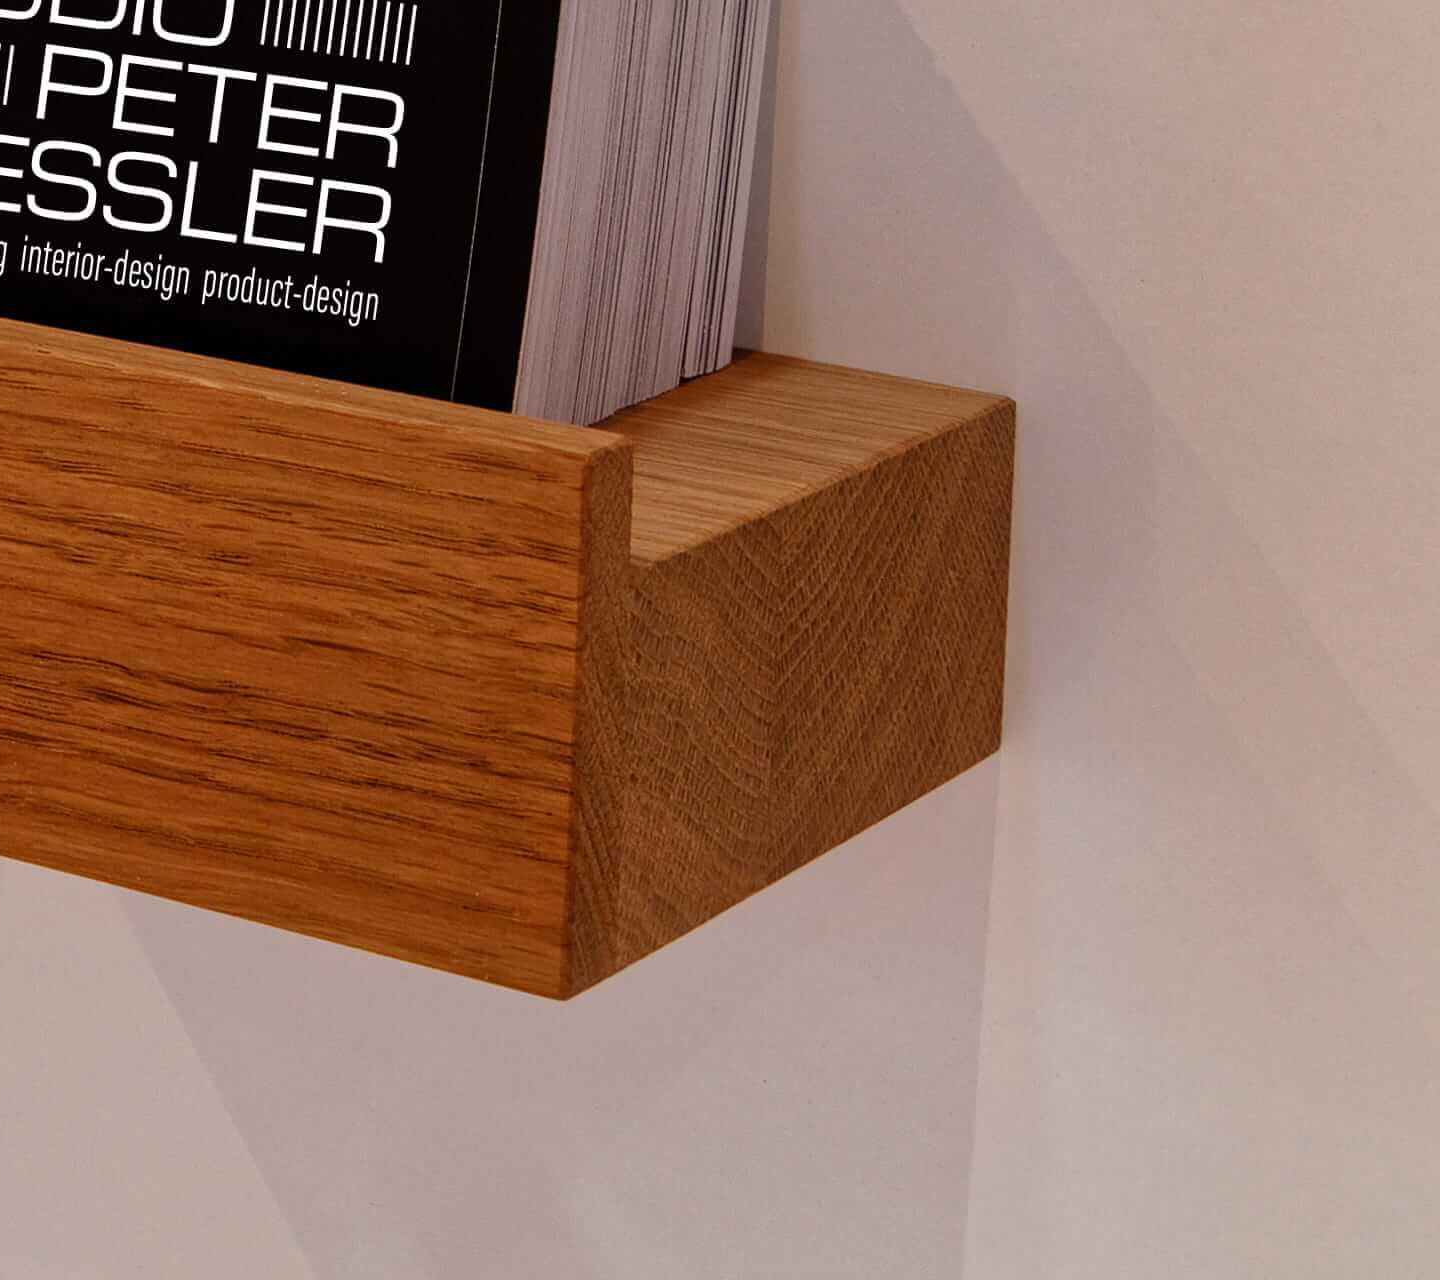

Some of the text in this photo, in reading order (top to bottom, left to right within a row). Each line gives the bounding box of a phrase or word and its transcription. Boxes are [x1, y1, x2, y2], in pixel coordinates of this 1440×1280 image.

[35, 43, 405, 169] PETER
[20, 235, 190, 301] interior-design
[201, 267, 380, 327] product-design
